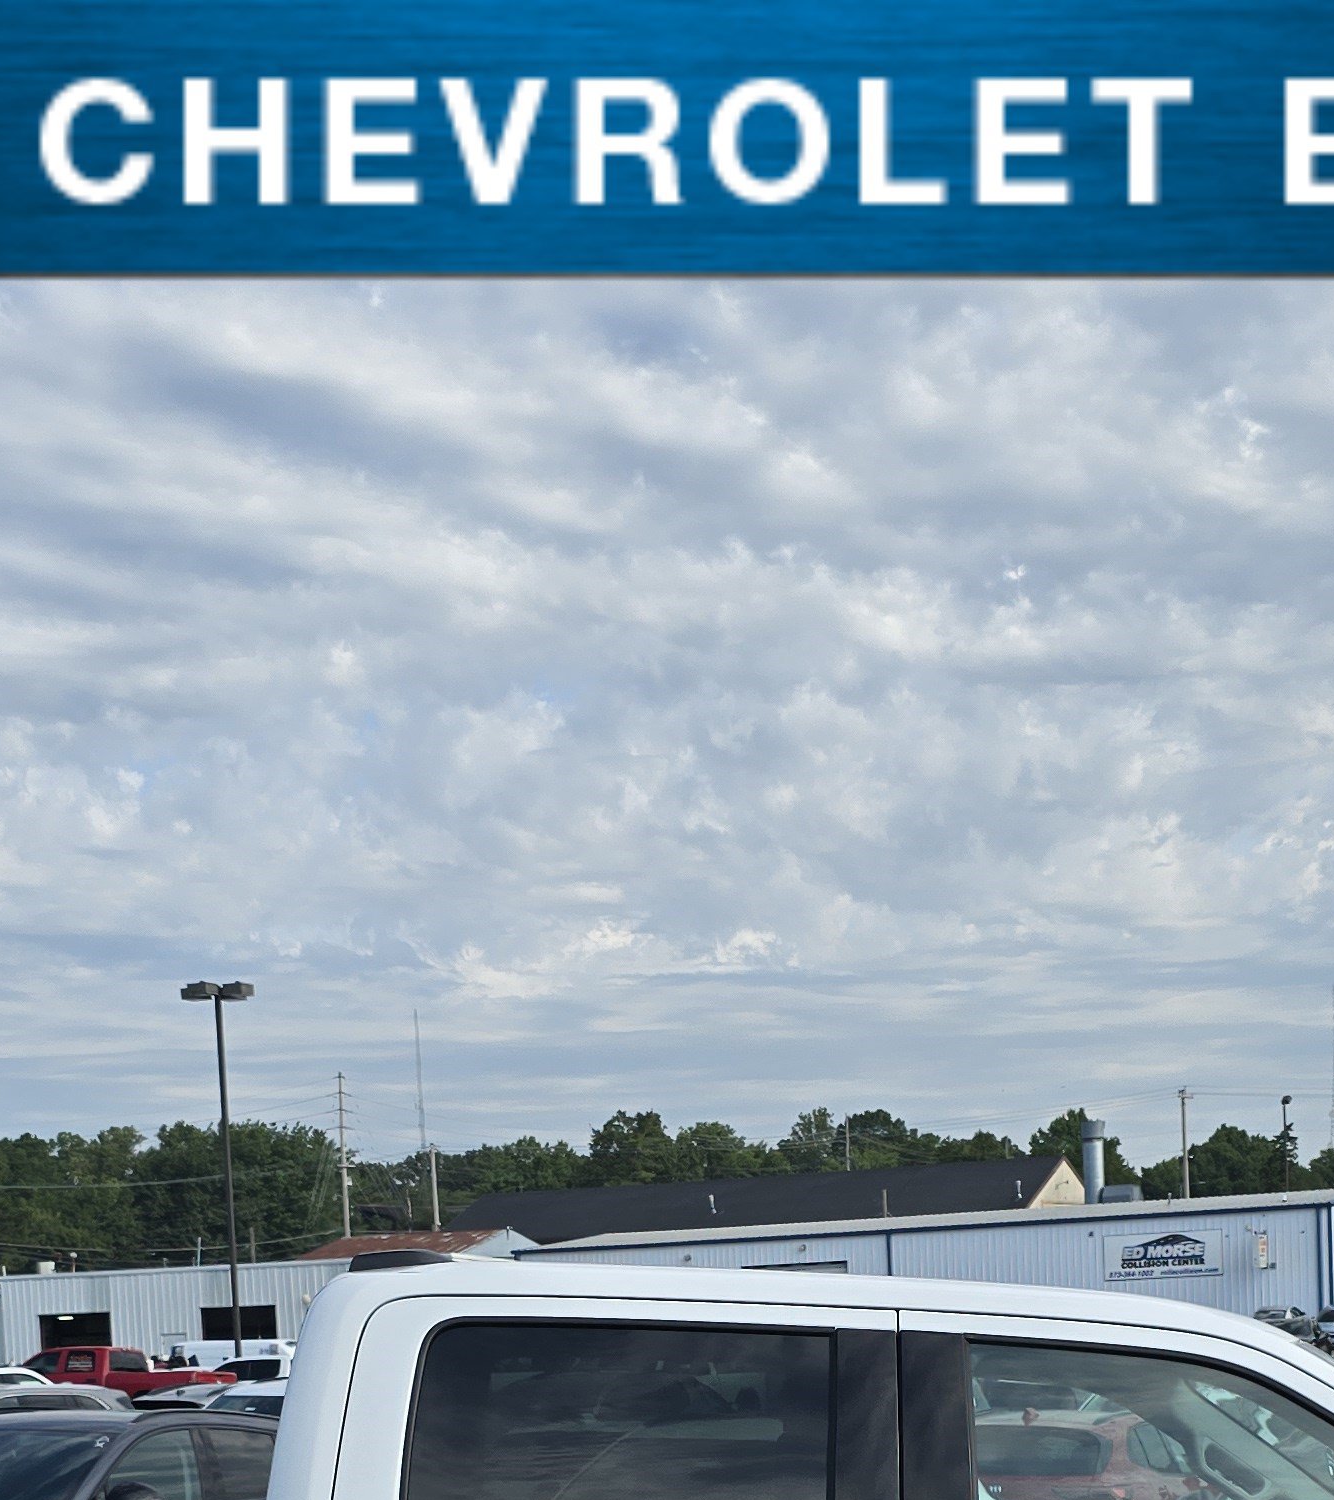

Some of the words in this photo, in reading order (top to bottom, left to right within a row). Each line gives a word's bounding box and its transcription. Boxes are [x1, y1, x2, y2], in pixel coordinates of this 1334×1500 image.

[1123, 1247, 1145, 1260] ED
[1146, 1242, 1205, 1259] MORSE
[1121, 1259, 1169, 1270] COLLISION
[1171, 1258, 1205, 1267] CENTER
